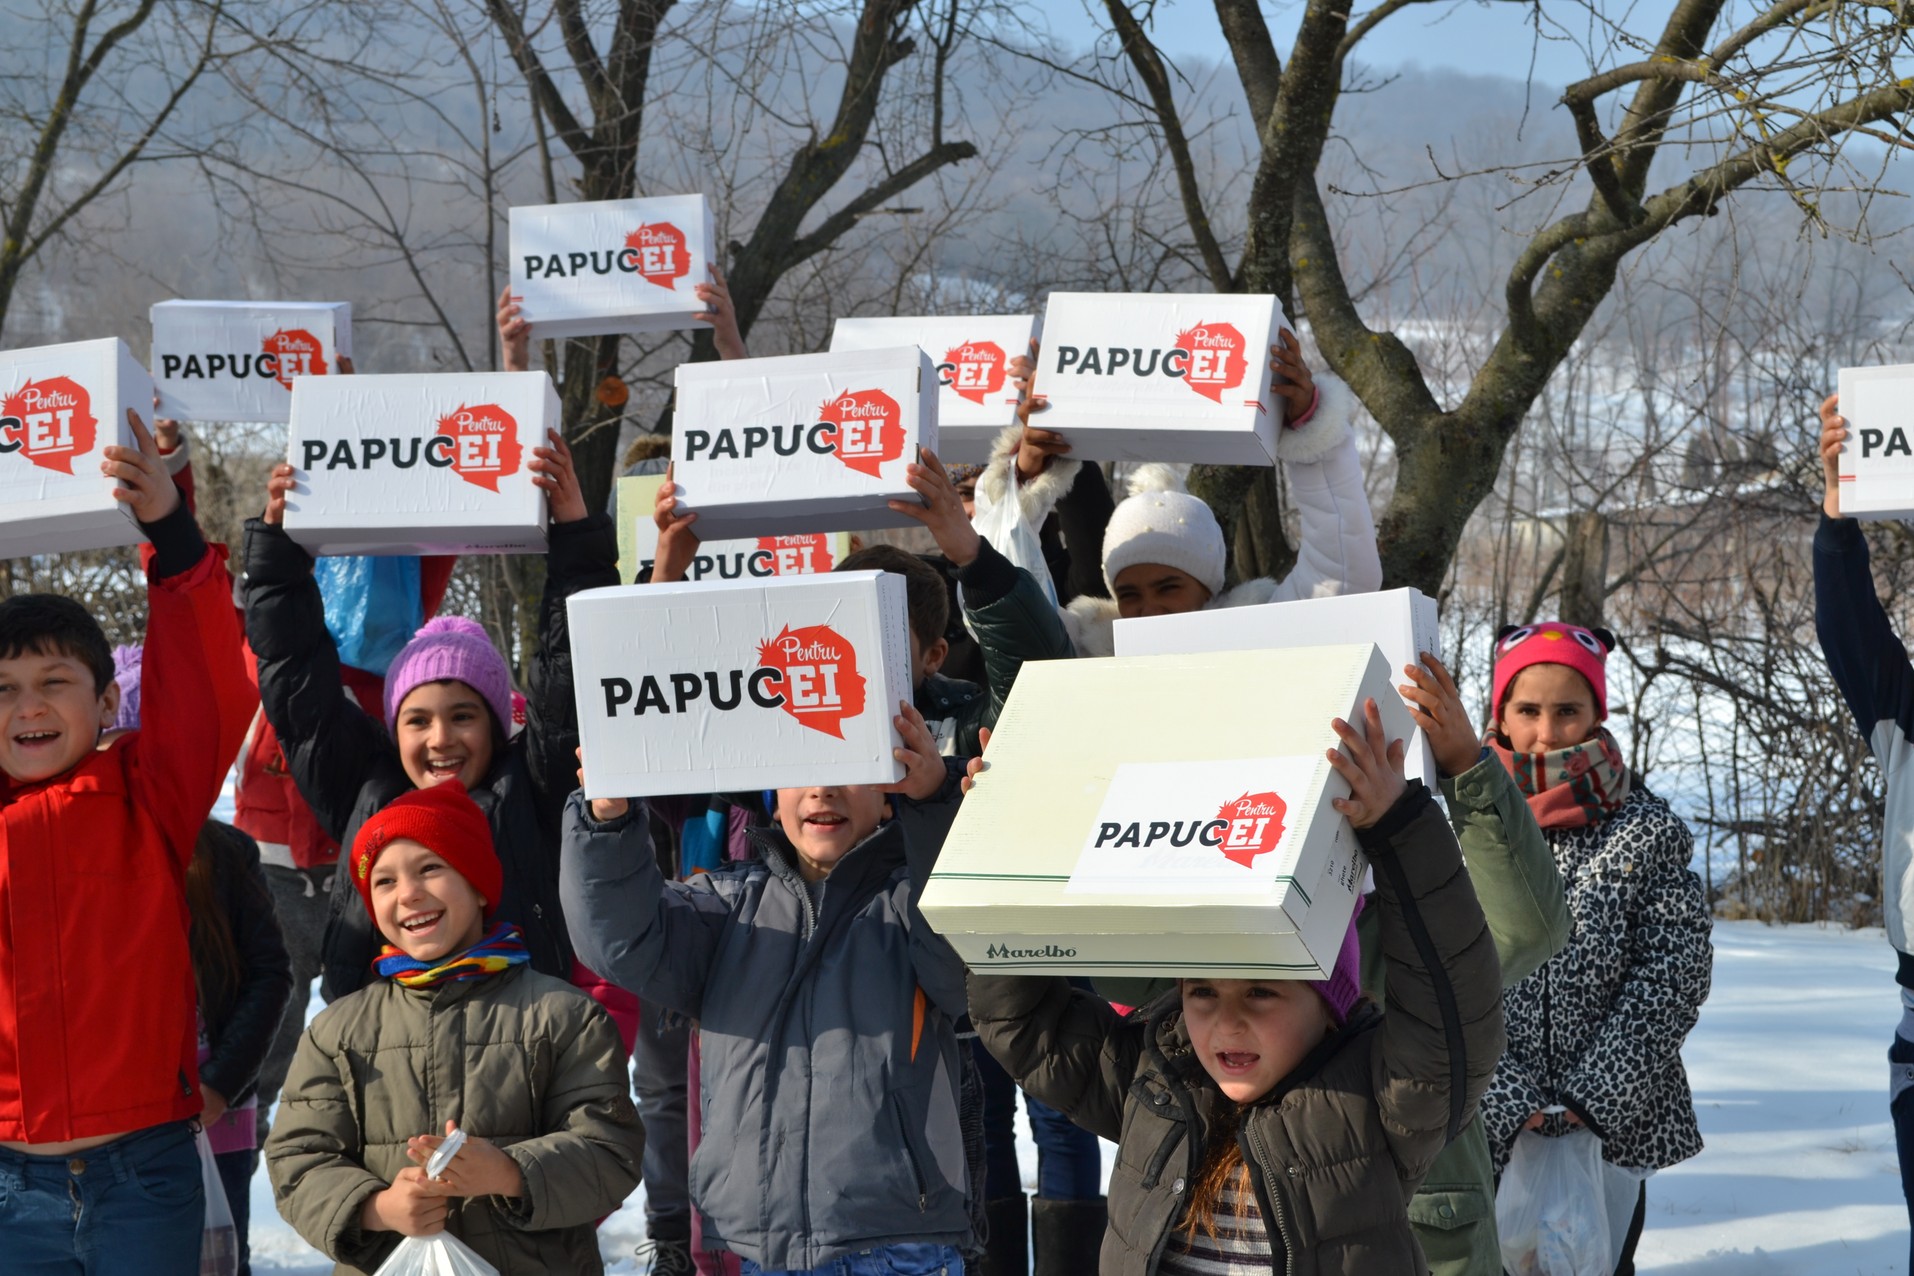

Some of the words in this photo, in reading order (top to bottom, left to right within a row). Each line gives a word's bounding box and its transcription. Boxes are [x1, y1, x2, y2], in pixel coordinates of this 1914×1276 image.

[637, 228, 678, 245] Pentru
[1190, 329, 1236, 349] Pentru
[956, 345, 998, 364] Pentru
[19, 388, 78, 412] Pentru
[836, 397, 889, 419] Pentru
[453, 411, 507, 433] Pentru
[777, 635, 842, 663] Pentru
[1234, 798, 1277, 819] Pentru
[986, 942, 1078, 960] Marelbo
